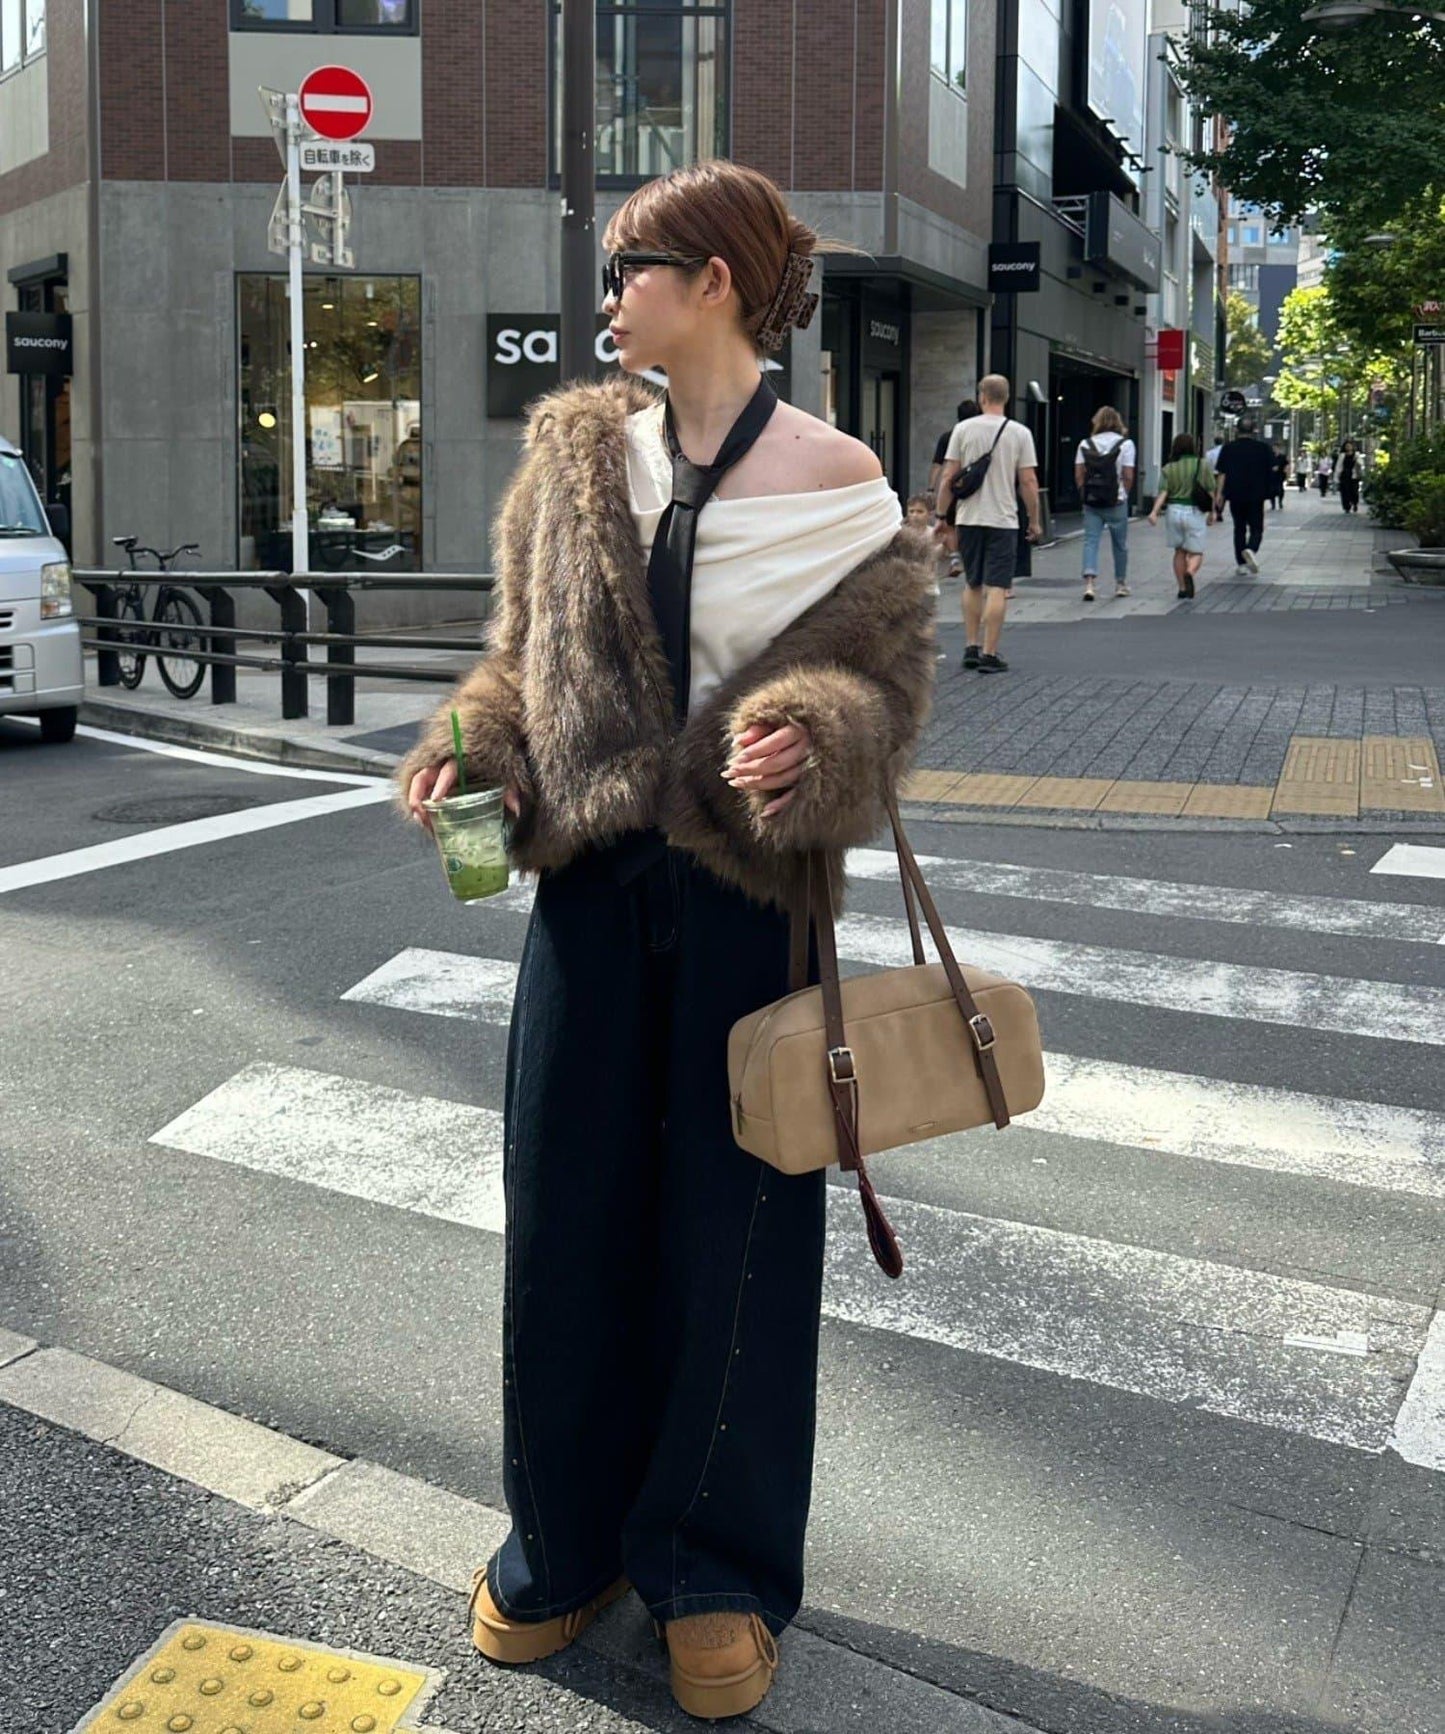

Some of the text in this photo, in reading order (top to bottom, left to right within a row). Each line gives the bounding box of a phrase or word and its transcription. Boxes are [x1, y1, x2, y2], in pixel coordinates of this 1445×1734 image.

[304, 149, 371, 167] 自転車を除く
[992, 261, 1036, 272] saucony
[870, 319, 900, 346] saucony
[13, 336, 68, 350] saucony
